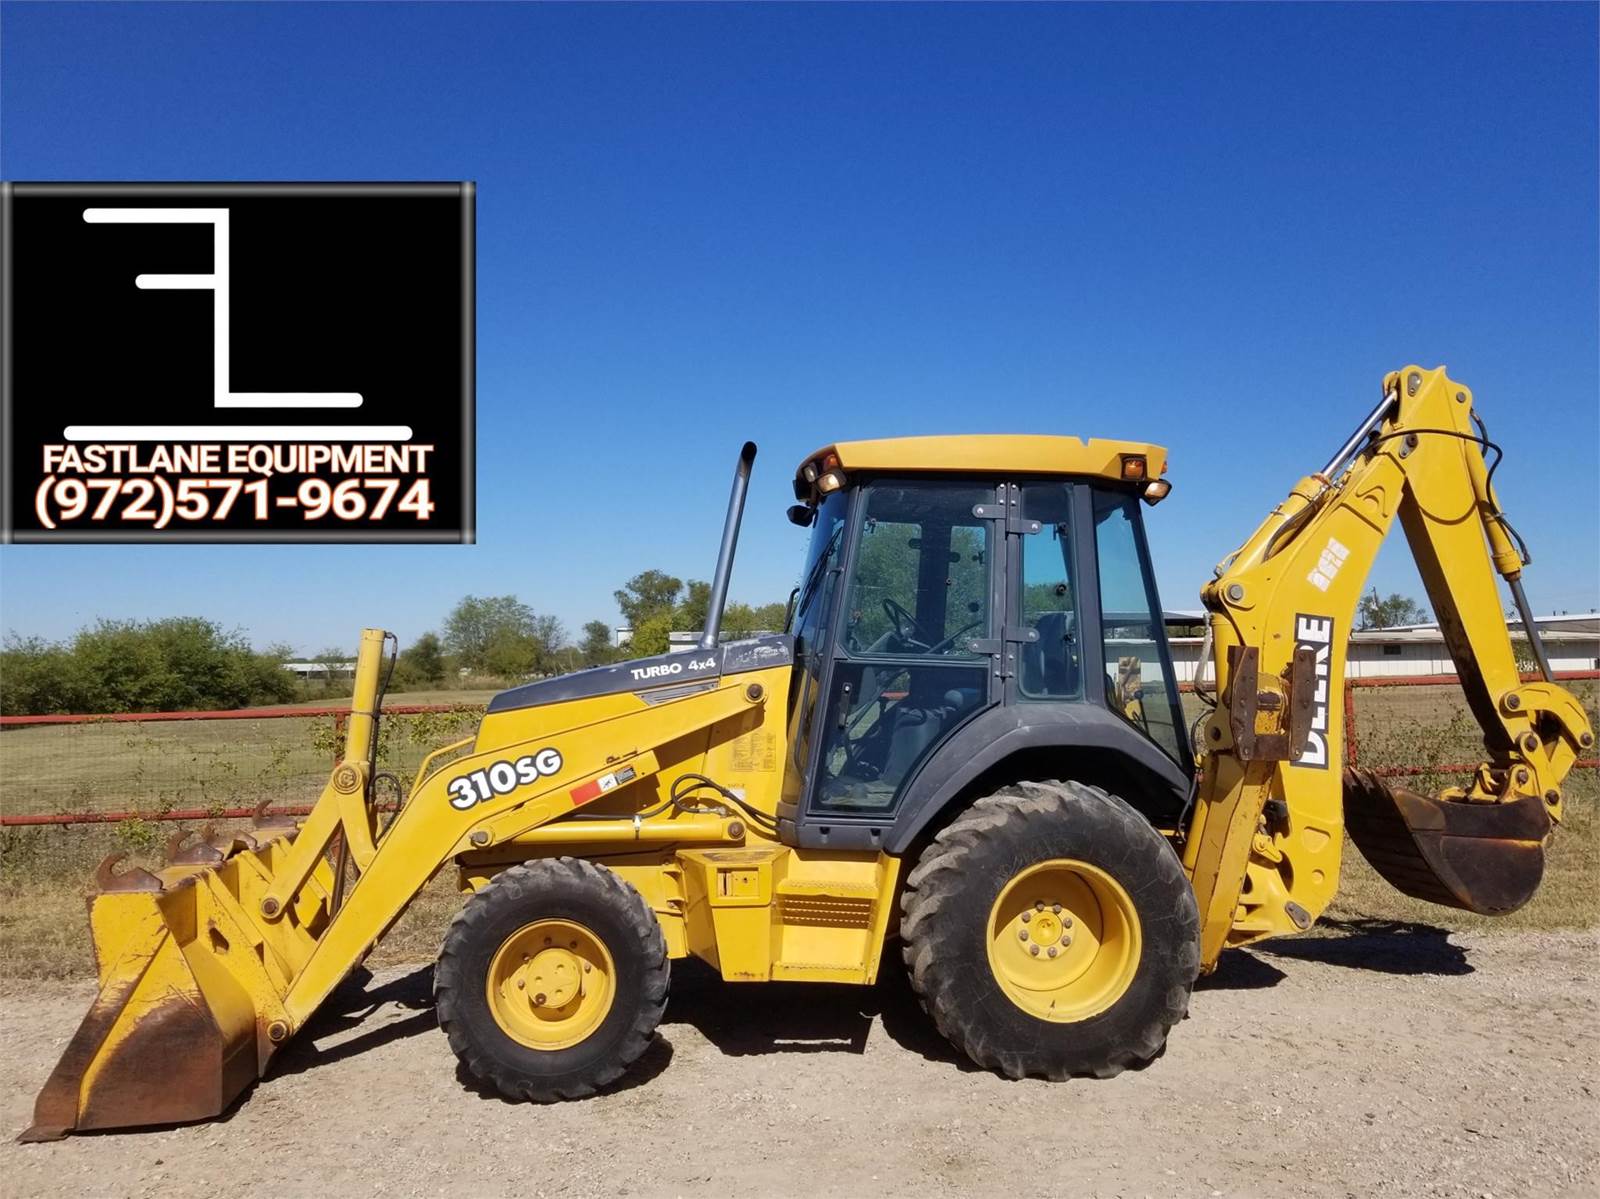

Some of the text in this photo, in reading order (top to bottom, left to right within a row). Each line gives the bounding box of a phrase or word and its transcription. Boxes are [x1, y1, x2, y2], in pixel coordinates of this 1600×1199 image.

[630, 657, 716, 681] TURBO 4x4
[448, 748, 563, 810] 310SG
